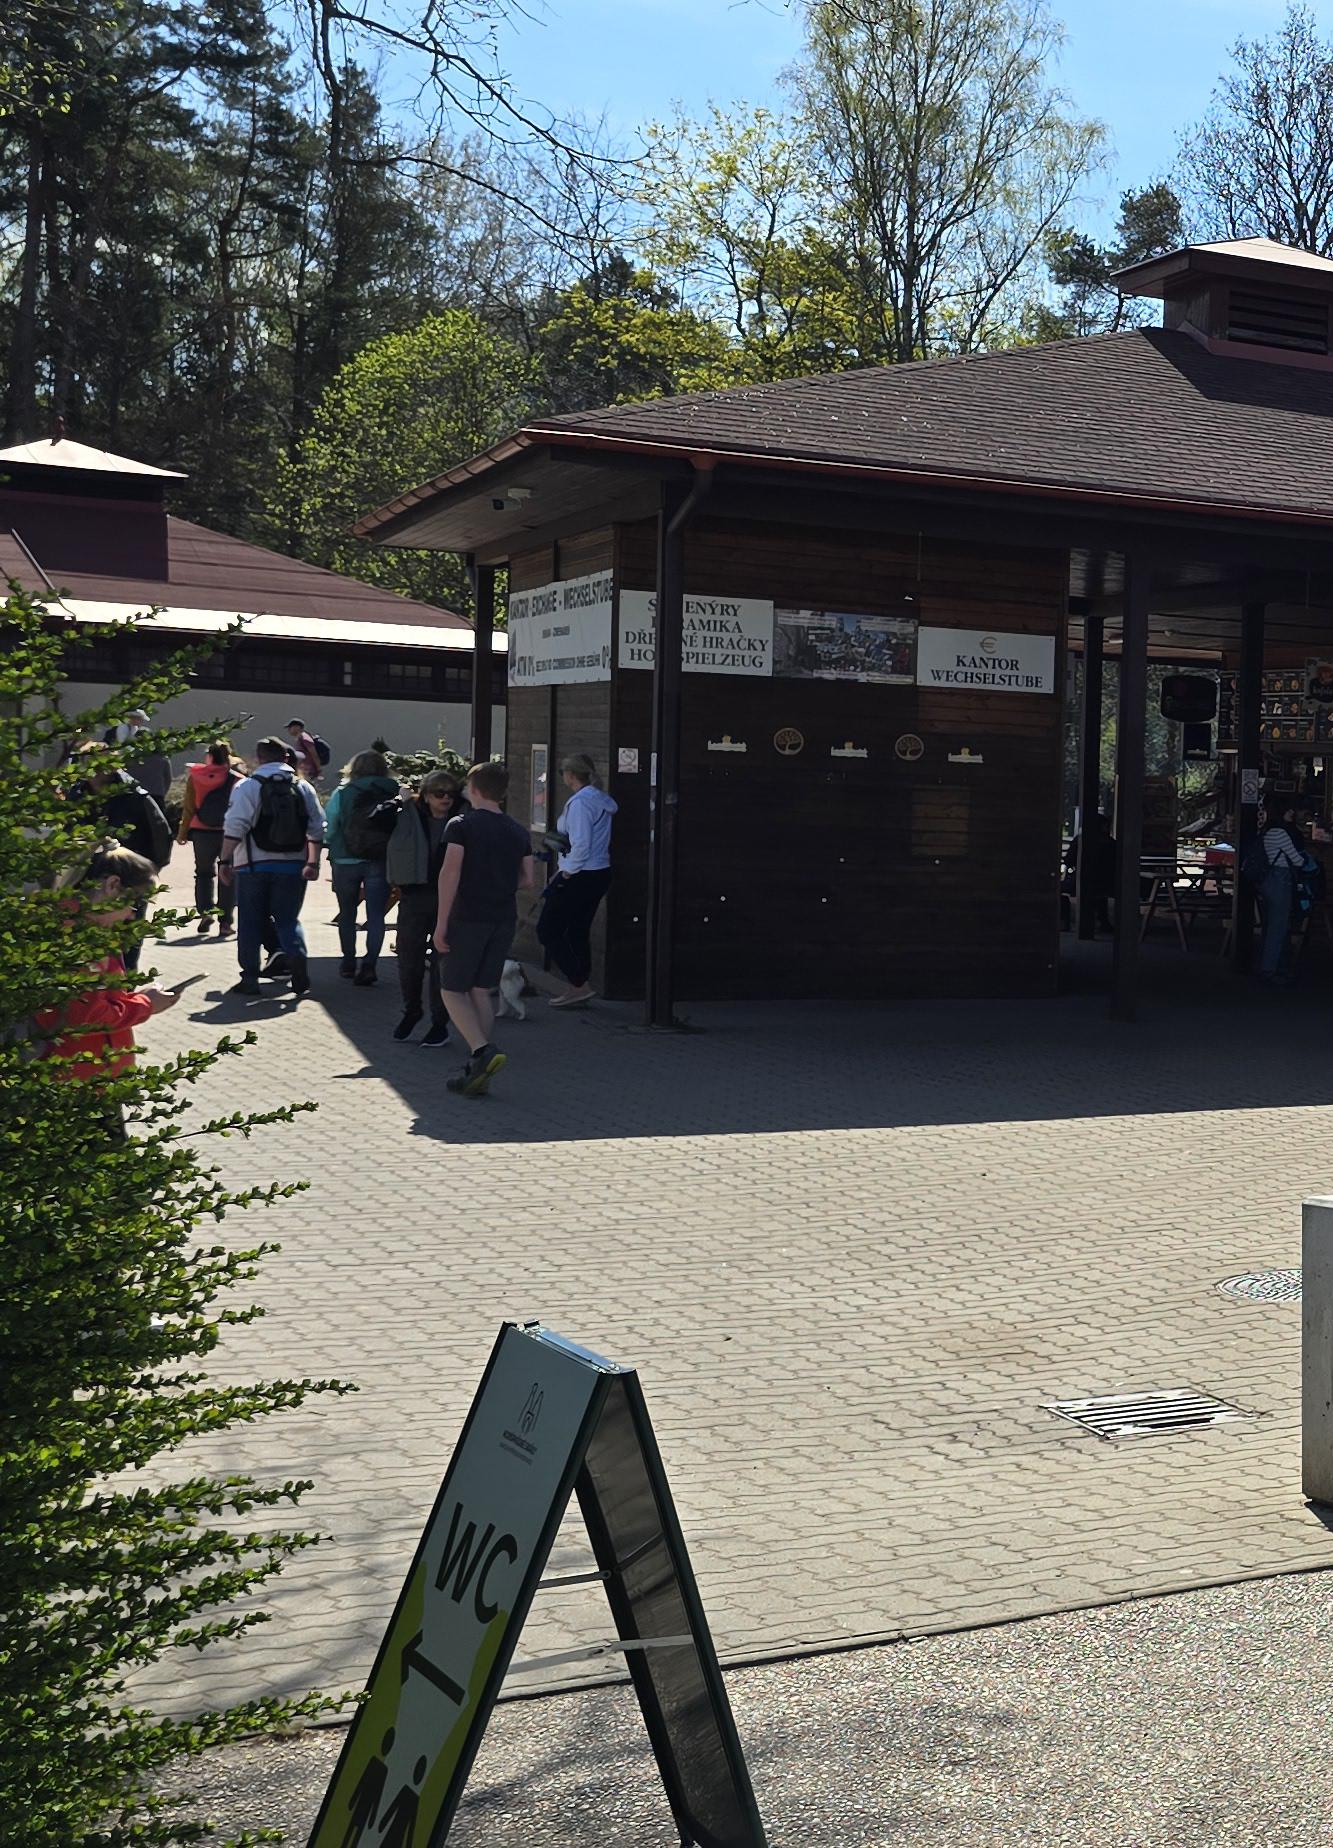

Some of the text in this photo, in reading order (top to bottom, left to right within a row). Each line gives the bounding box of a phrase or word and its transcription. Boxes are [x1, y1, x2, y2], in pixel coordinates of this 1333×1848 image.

[648, 599, 742, 617] SENÝRY
[625, 629, 769, 653] DŘENÉ HRAČKY
[955, 654, 1019, 671] KANTOR
[930, 669, 1043, 689] WECHSELSTUBE
[434, 1501, 519, 1624] WC
